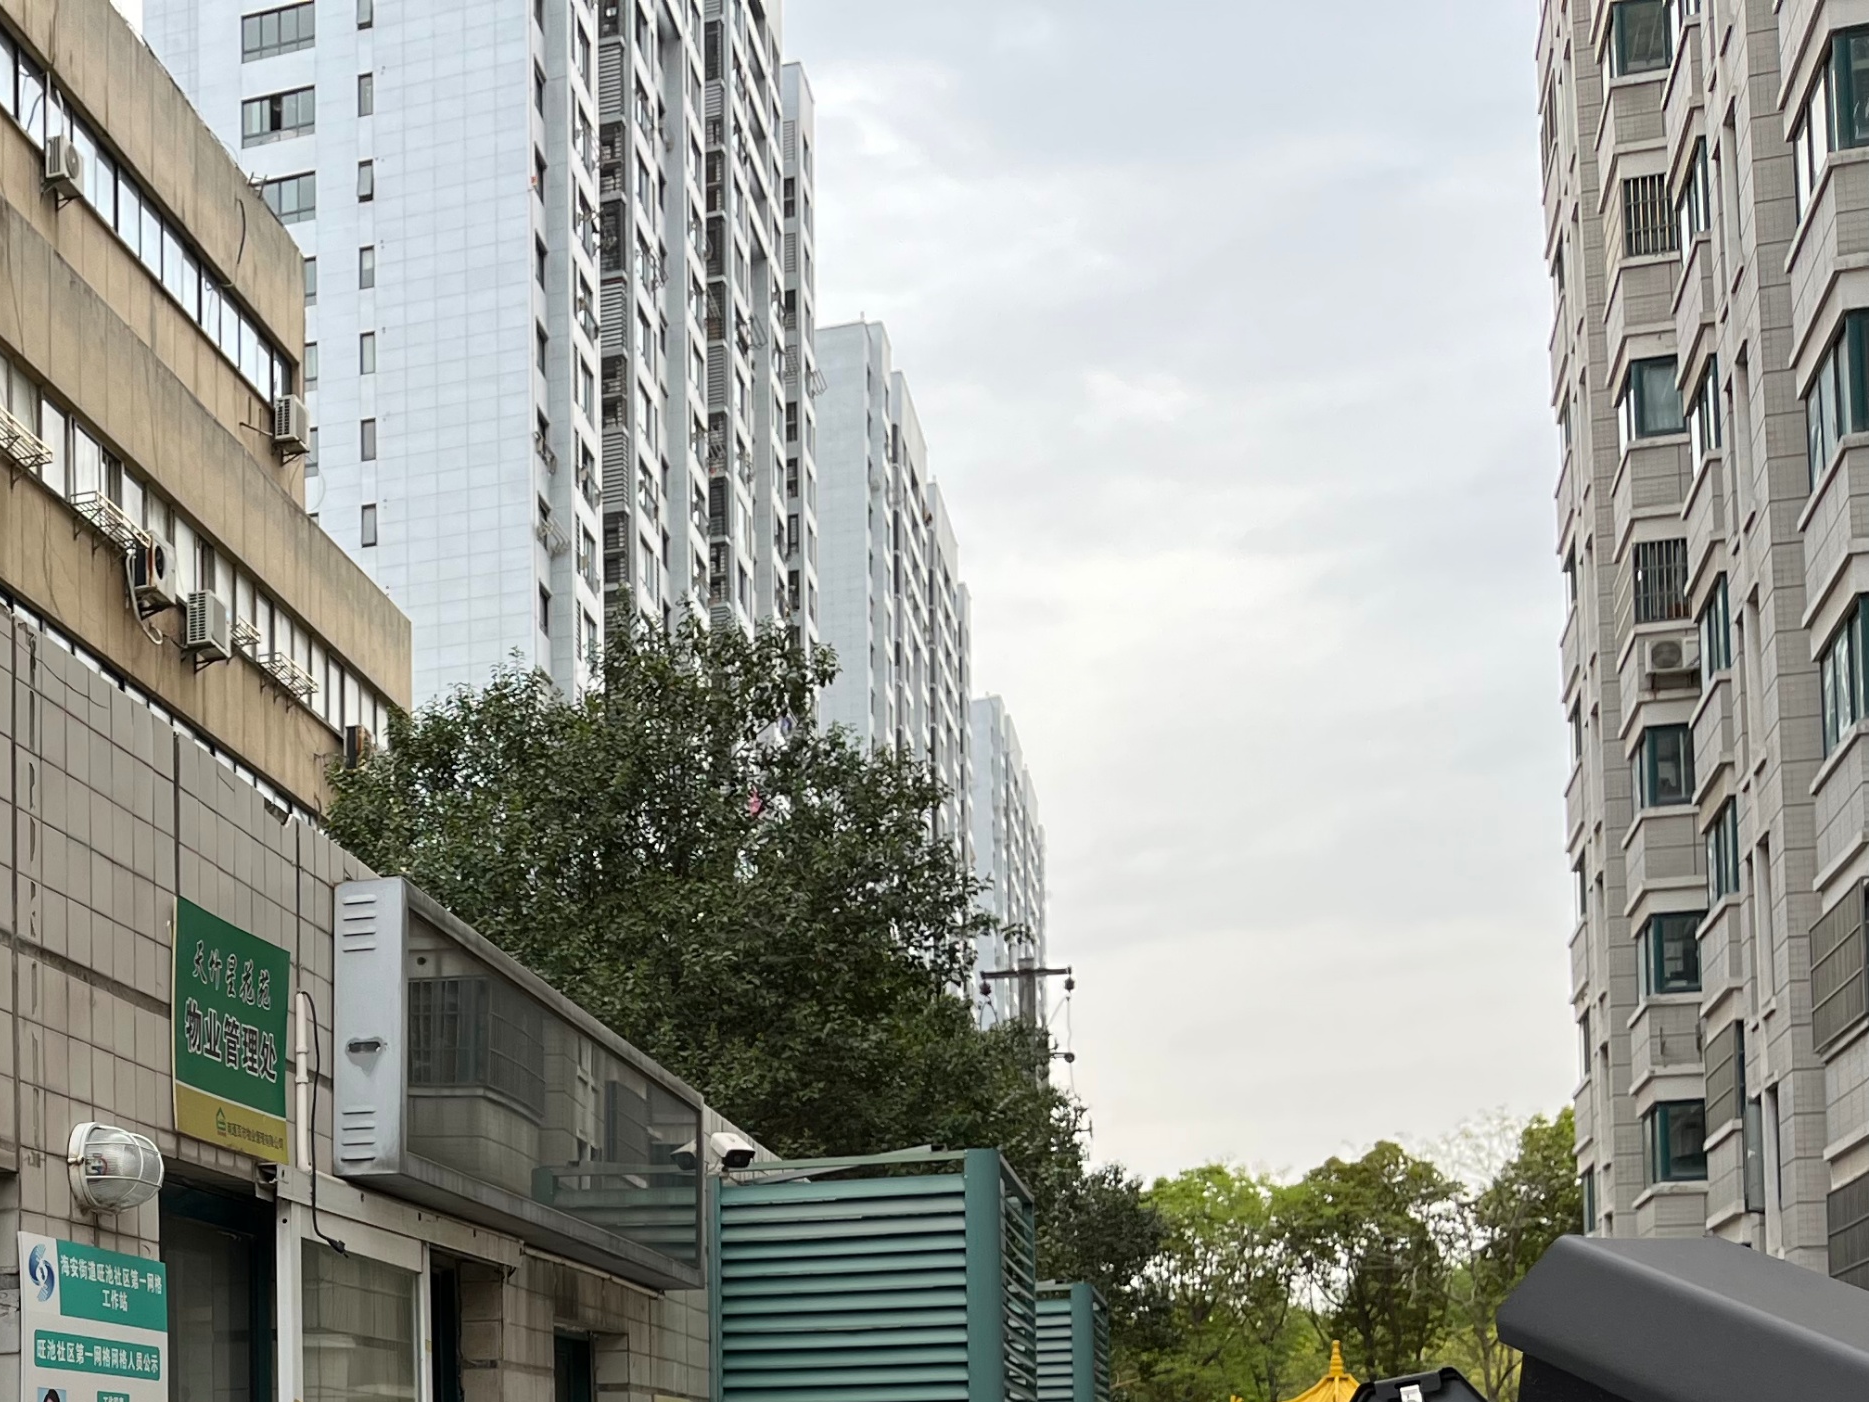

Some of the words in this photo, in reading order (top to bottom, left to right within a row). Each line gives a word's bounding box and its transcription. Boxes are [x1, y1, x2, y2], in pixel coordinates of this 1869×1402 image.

[185, 997, 277, 1083] 物业管理处
[60, 1255, 162, 1294] 海安街道旺池社区第一网格
[102, 1289, 128, 1312] 工作站
[37, 1339, 159, 1374] 旺池社区第一网格网格人员公示
